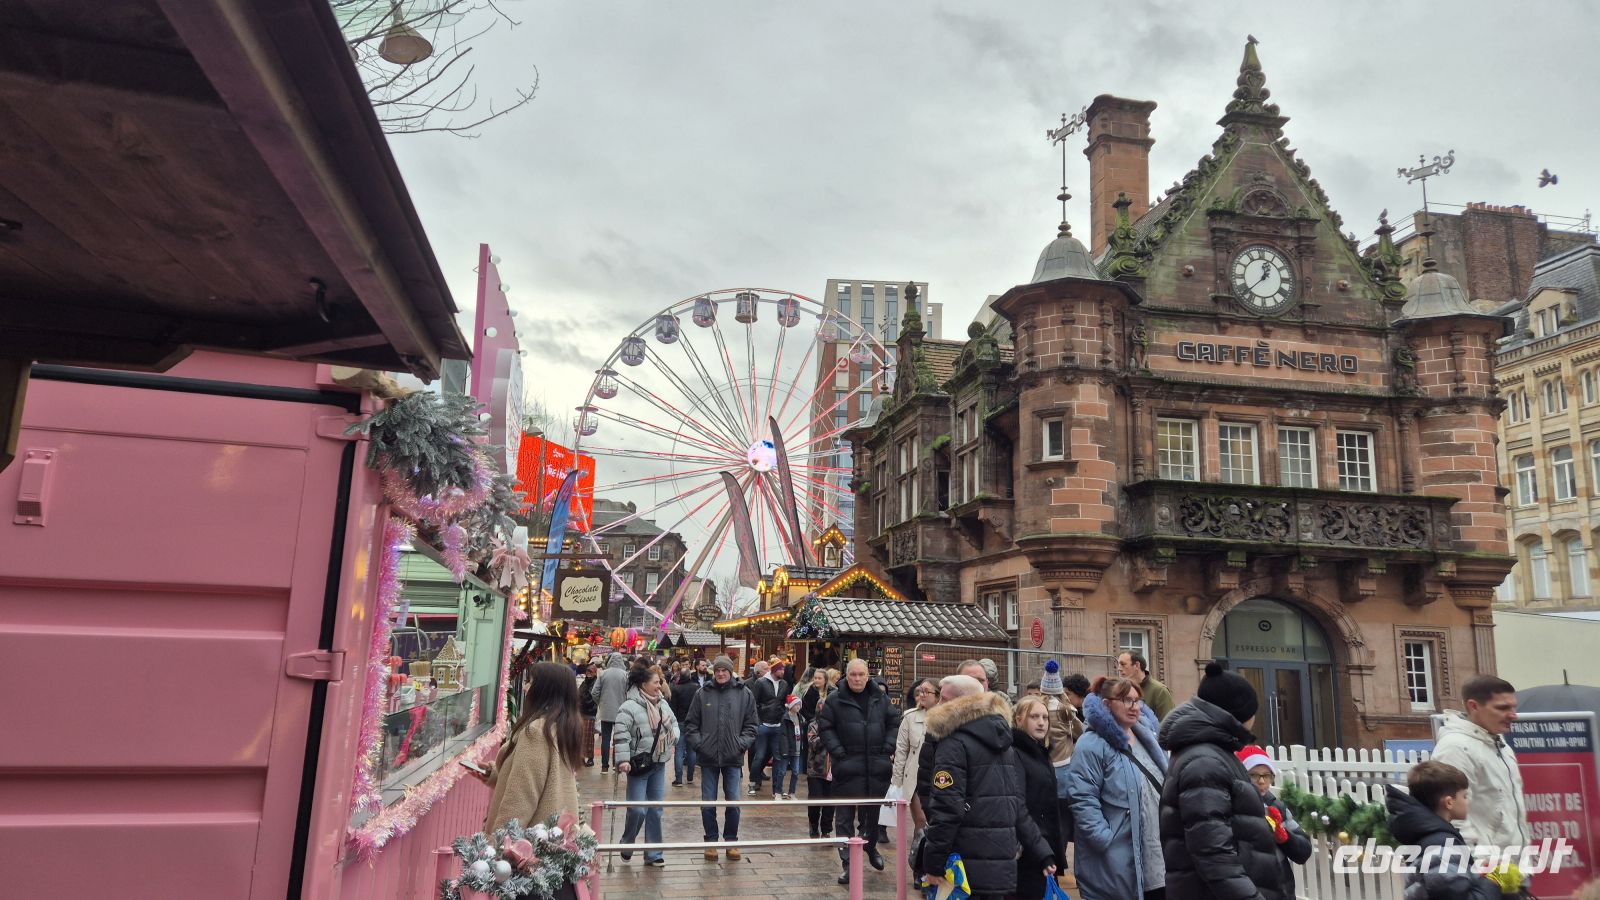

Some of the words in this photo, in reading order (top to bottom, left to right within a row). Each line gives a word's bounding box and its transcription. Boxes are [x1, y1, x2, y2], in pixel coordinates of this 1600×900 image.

[1176, 340, 1271, 367] CAFFÈ
[1276, 349, 1360, 374] NERO
[564, 584, 600, 598] Chocolate
[572, 595, 597, 604] Kisses
[1235, 645, 1277, 653] ESPRESSO
[885, 658, 903, 666] WINE
[1524, 793, 1562, 812] MUST
[1565, 793, 1583, 812] BE
[1525, 821, 1560, 840] ASED
[1562, 821, 1581, 839] TO
